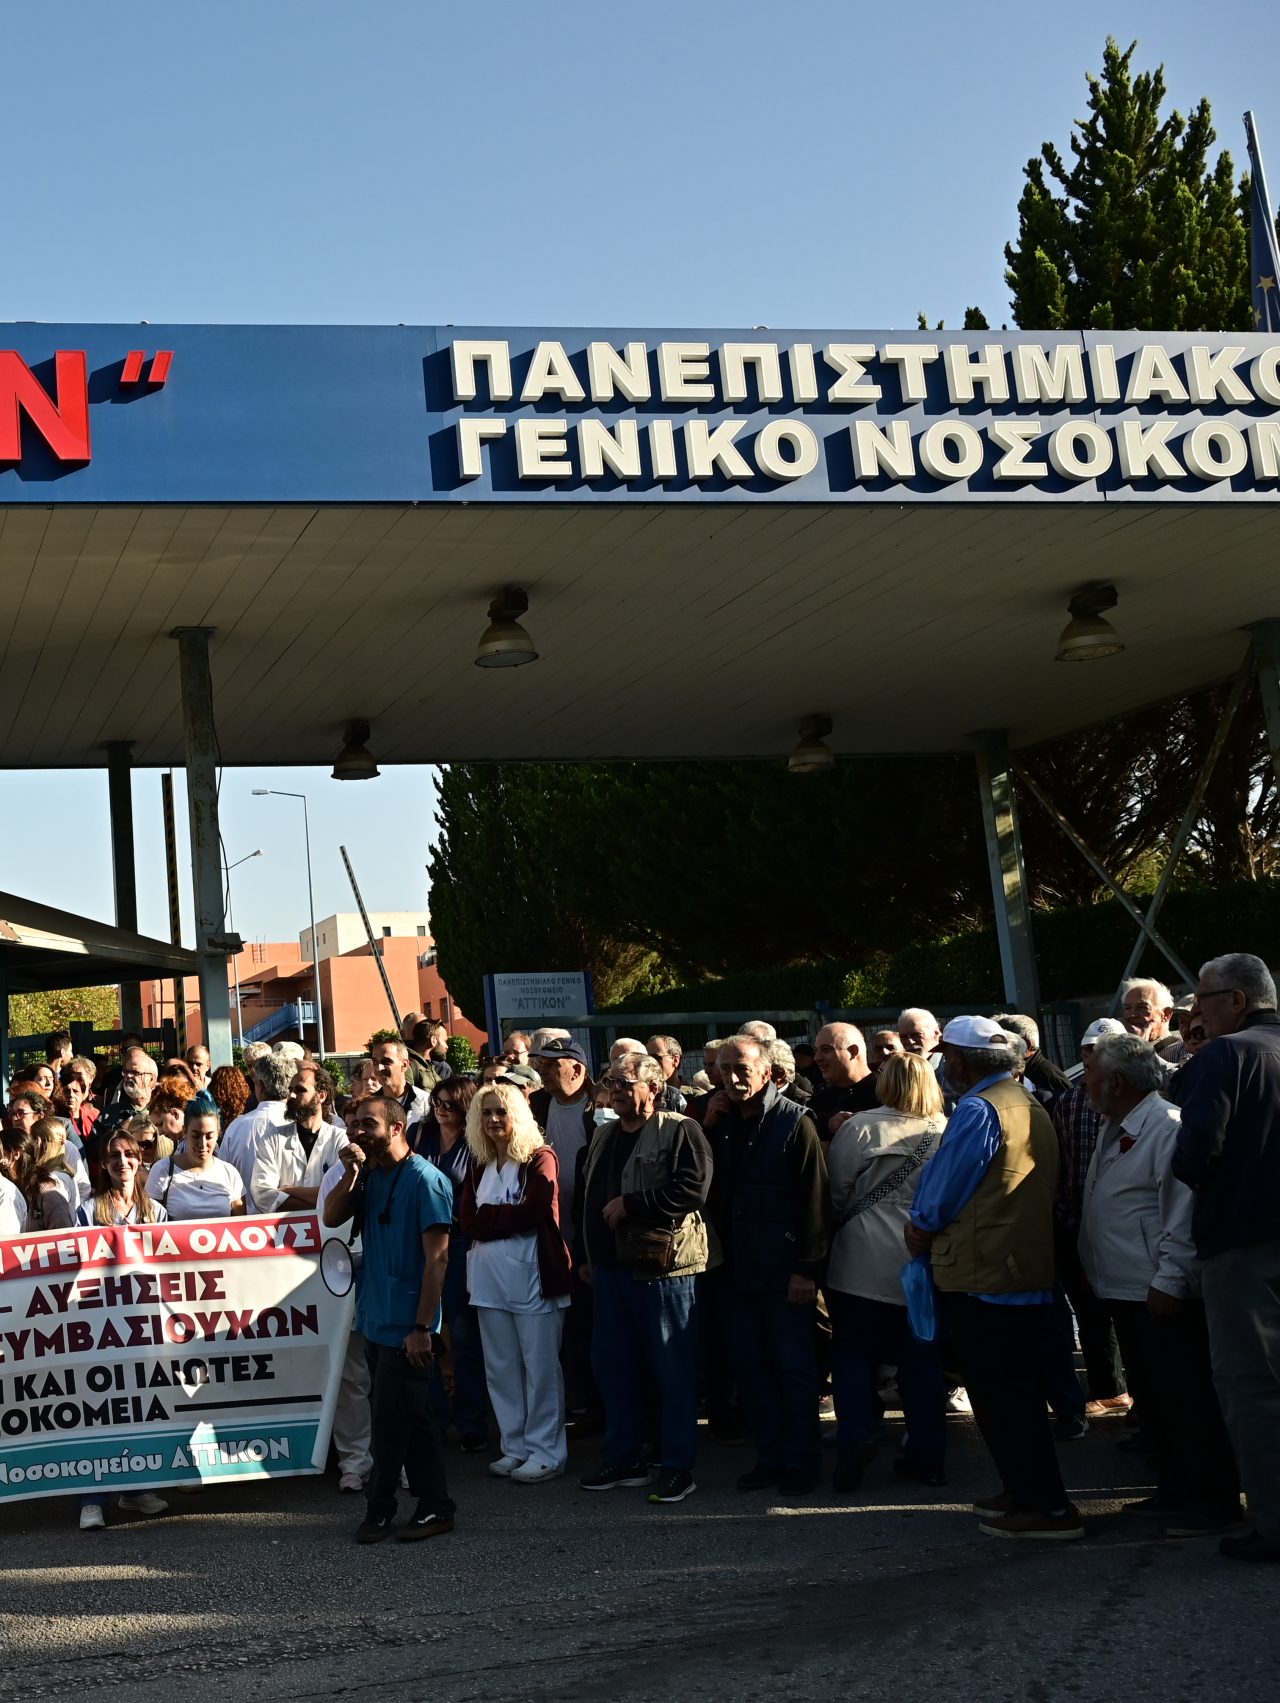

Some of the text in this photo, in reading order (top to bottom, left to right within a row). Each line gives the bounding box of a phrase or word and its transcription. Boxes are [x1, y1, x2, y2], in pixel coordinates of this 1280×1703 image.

[457, 418, 819, 481] ΓΕΝΙΚΟ
[498, 977, 581, 986] ΠΑΝΕΠΙΣΤΗΜΙΑΚΟ ΓΕΝΙΚΟ
[520, 987, 563, 995] ΝΟΣΟΚΟΜΕΙΟ
[512, 996, 571, 1010] "ΑΤΤΙΚΟΝ"
[12, 1232, 115, 1270] ΥΓΕΙΑ
[124, 1230, 180, 1257] ΓΙΑ
[189, 1222, 315, 1254] ΟΛΟΥΣ
[25, 1270, 226, 1318] ΑΥΞΗΣΕΙΣ
[14, 1369, 75, 1402] ΚΑΙ
[86, 1363, 124, 1393] ΟΙ
[135, 1353, 275, 1388] ΙΔΙΩΤΕΣ
[171, 1436, 290, 1469] ΑΤΤΙΚΟΝ
